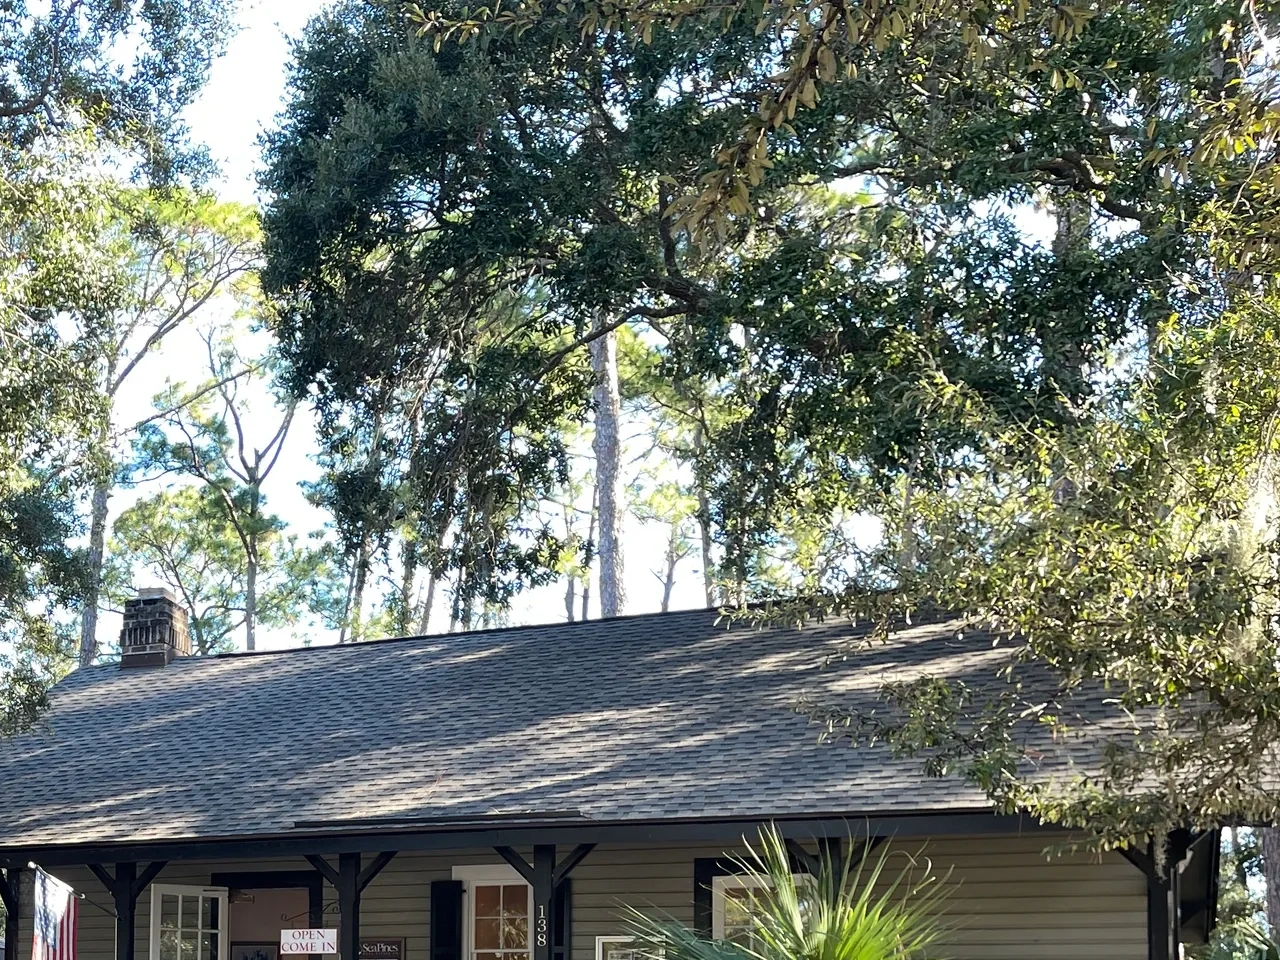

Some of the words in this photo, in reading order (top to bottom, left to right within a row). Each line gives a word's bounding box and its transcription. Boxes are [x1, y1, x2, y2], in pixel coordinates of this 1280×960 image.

[537, 905, 547, 947] 138
[292, 930, 326, 940] OPEN
[281, 942, 317, 952] COME
[322, 942, 336, 951] IN
